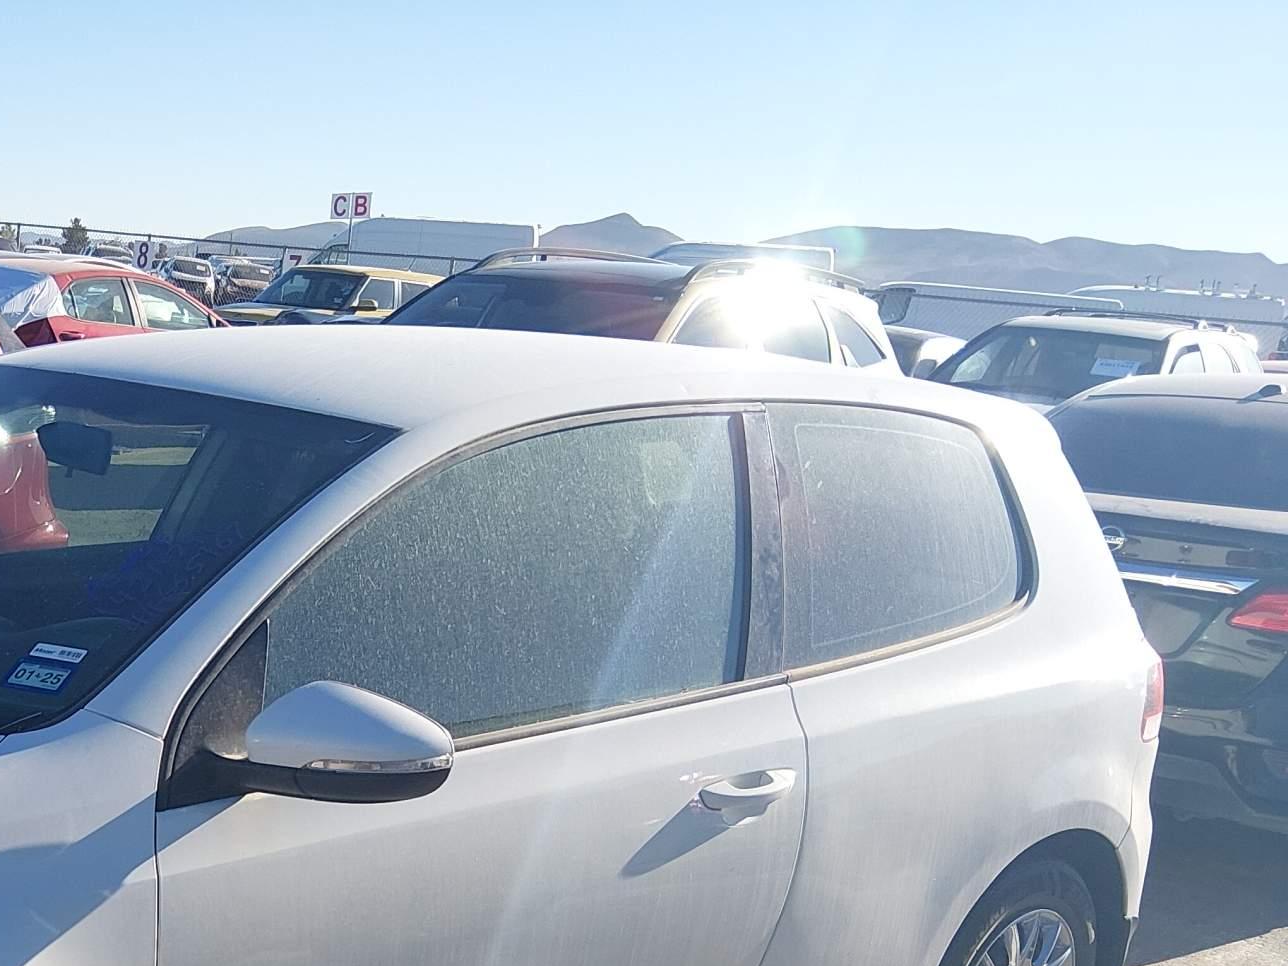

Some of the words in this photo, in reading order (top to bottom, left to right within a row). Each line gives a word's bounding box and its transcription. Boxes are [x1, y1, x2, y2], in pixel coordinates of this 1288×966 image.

[333, 195, 347, 217] C
[354, 195, 368, 217] B
[137, 242, 149, 269] 8
